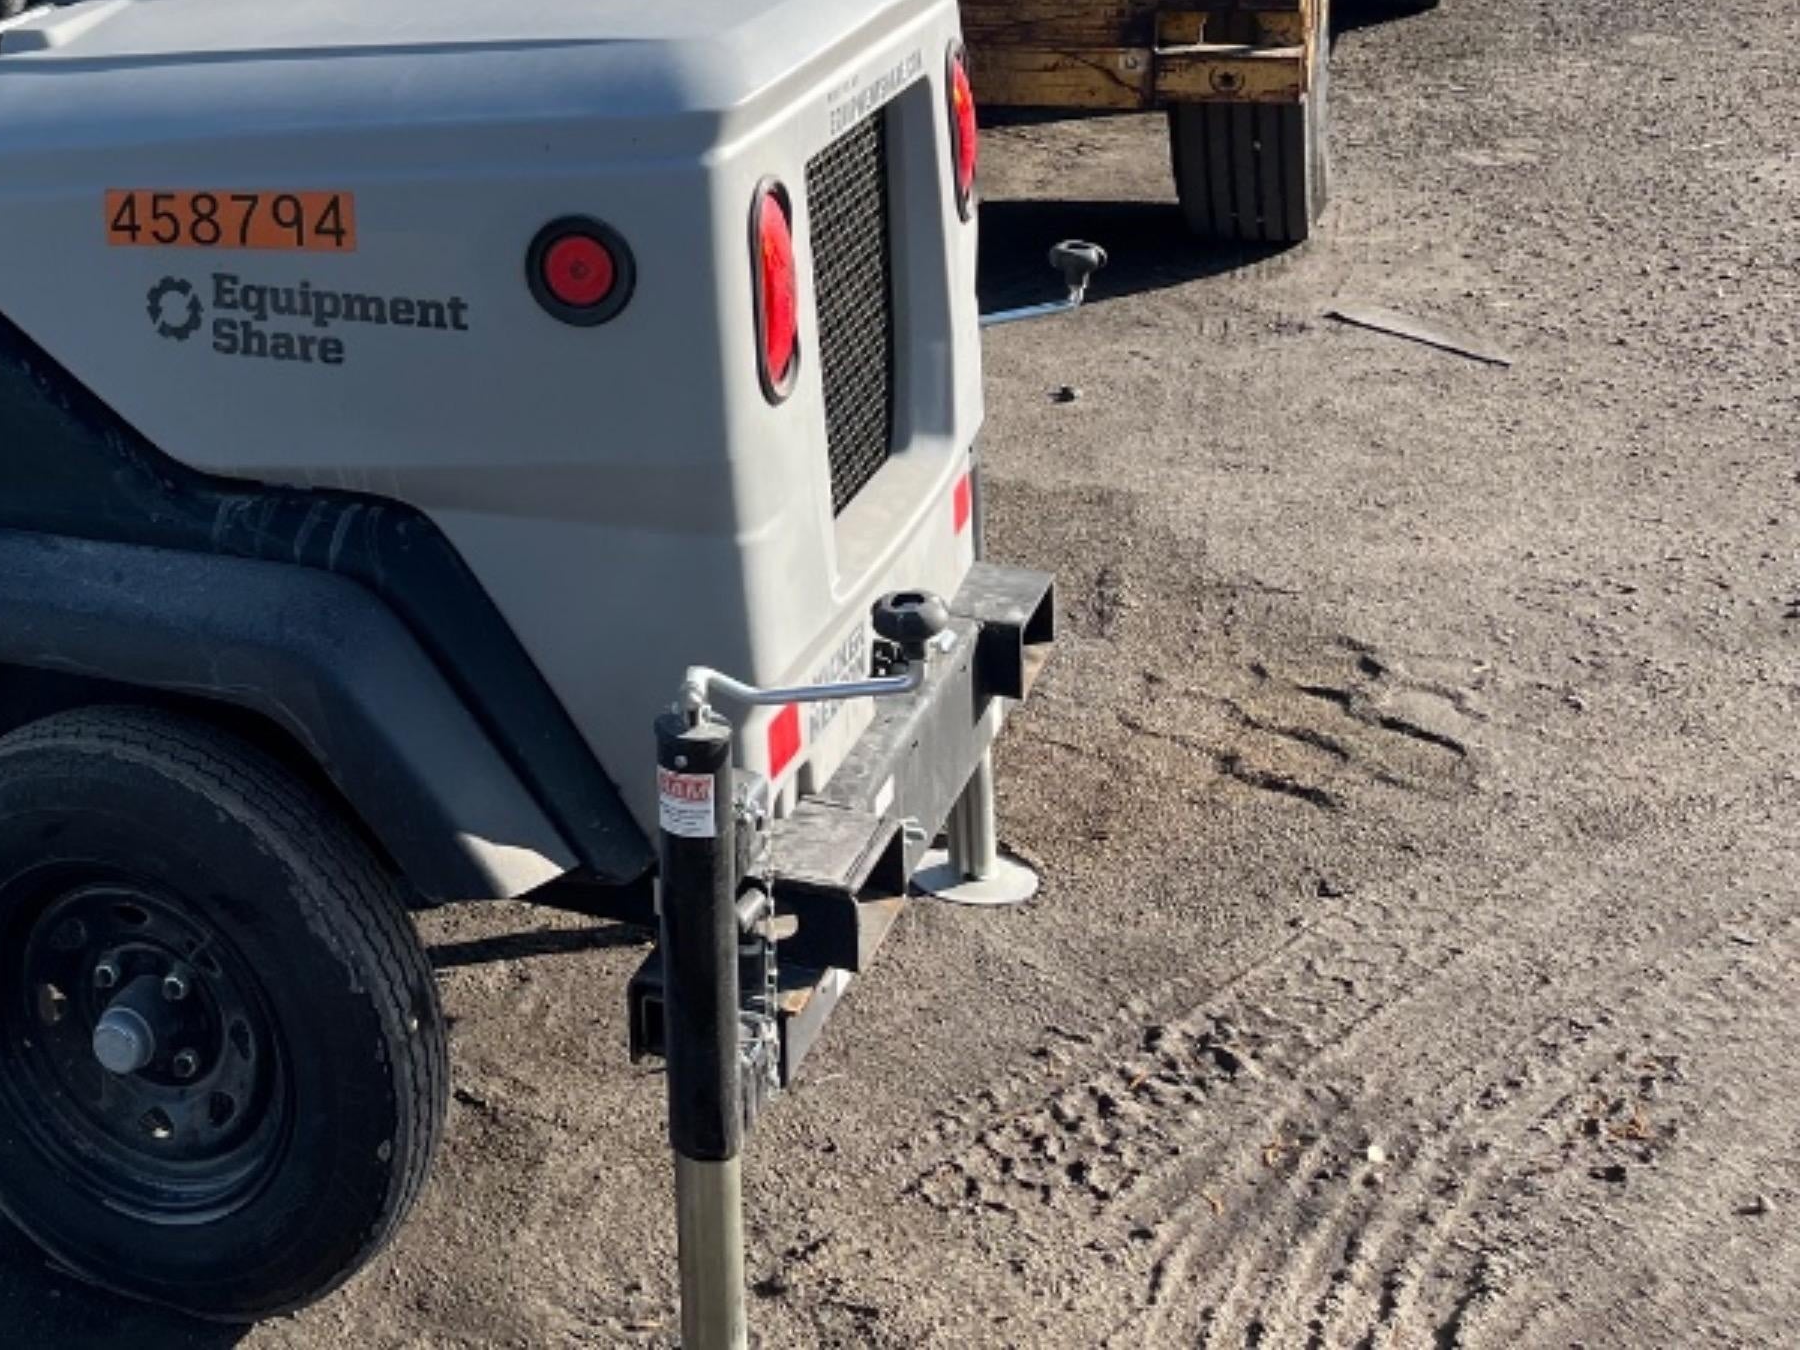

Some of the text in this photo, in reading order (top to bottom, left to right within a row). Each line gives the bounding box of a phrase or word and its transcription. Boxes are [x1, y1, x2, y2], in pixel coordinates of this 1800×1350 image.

[109, 191, 348, 247] 458794
[211, 272, 470, 332] Equipment
[212, 317, 346, 365] Share
